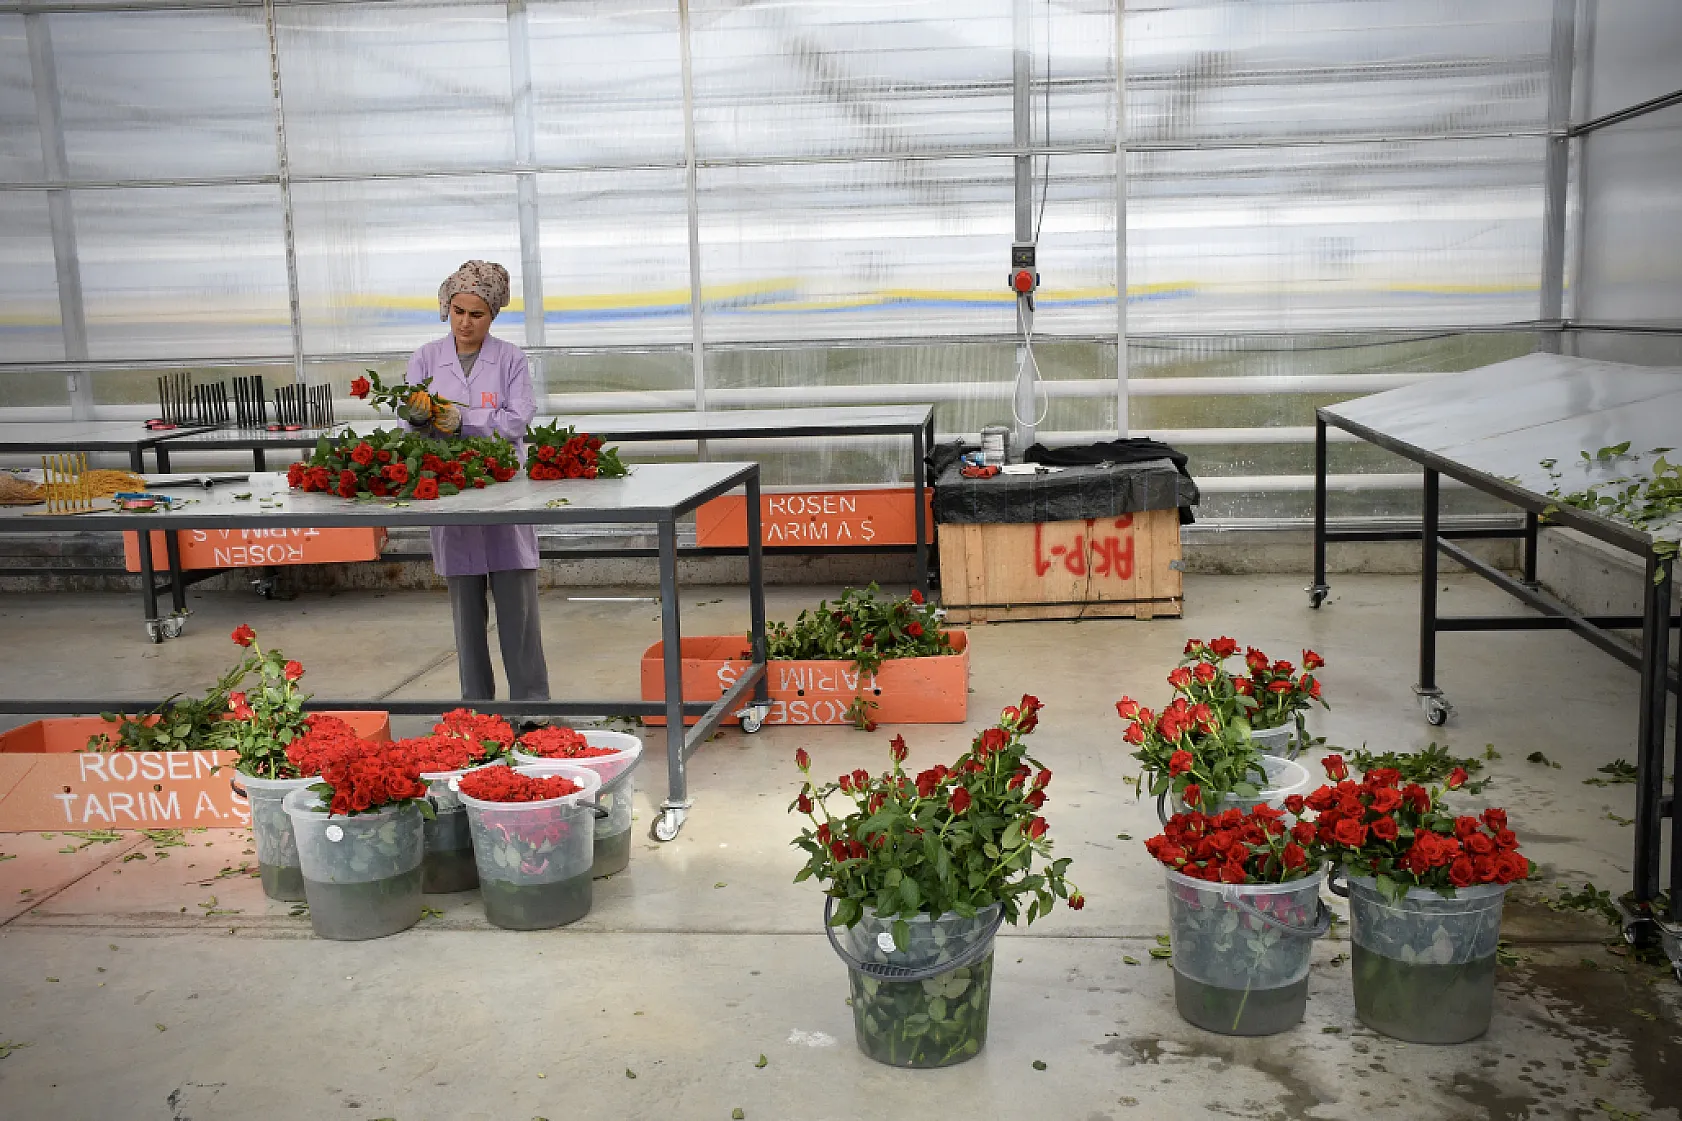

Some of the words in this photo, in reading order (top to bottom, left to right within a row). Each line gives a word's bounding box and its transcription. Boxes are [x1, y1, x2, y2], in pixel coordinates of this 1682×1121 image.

[769, 495, 856, 516] ROSEN
[761, 520, 828, 541] ARIM
[213, 543, 304, 567] ROSEN
[780, 666, 882, 691] TARIM
[767, 699, 859, 724] ROSE
[79, 750, 221, 782] ROSEN
[54, 790, 182, 823] TARIM
